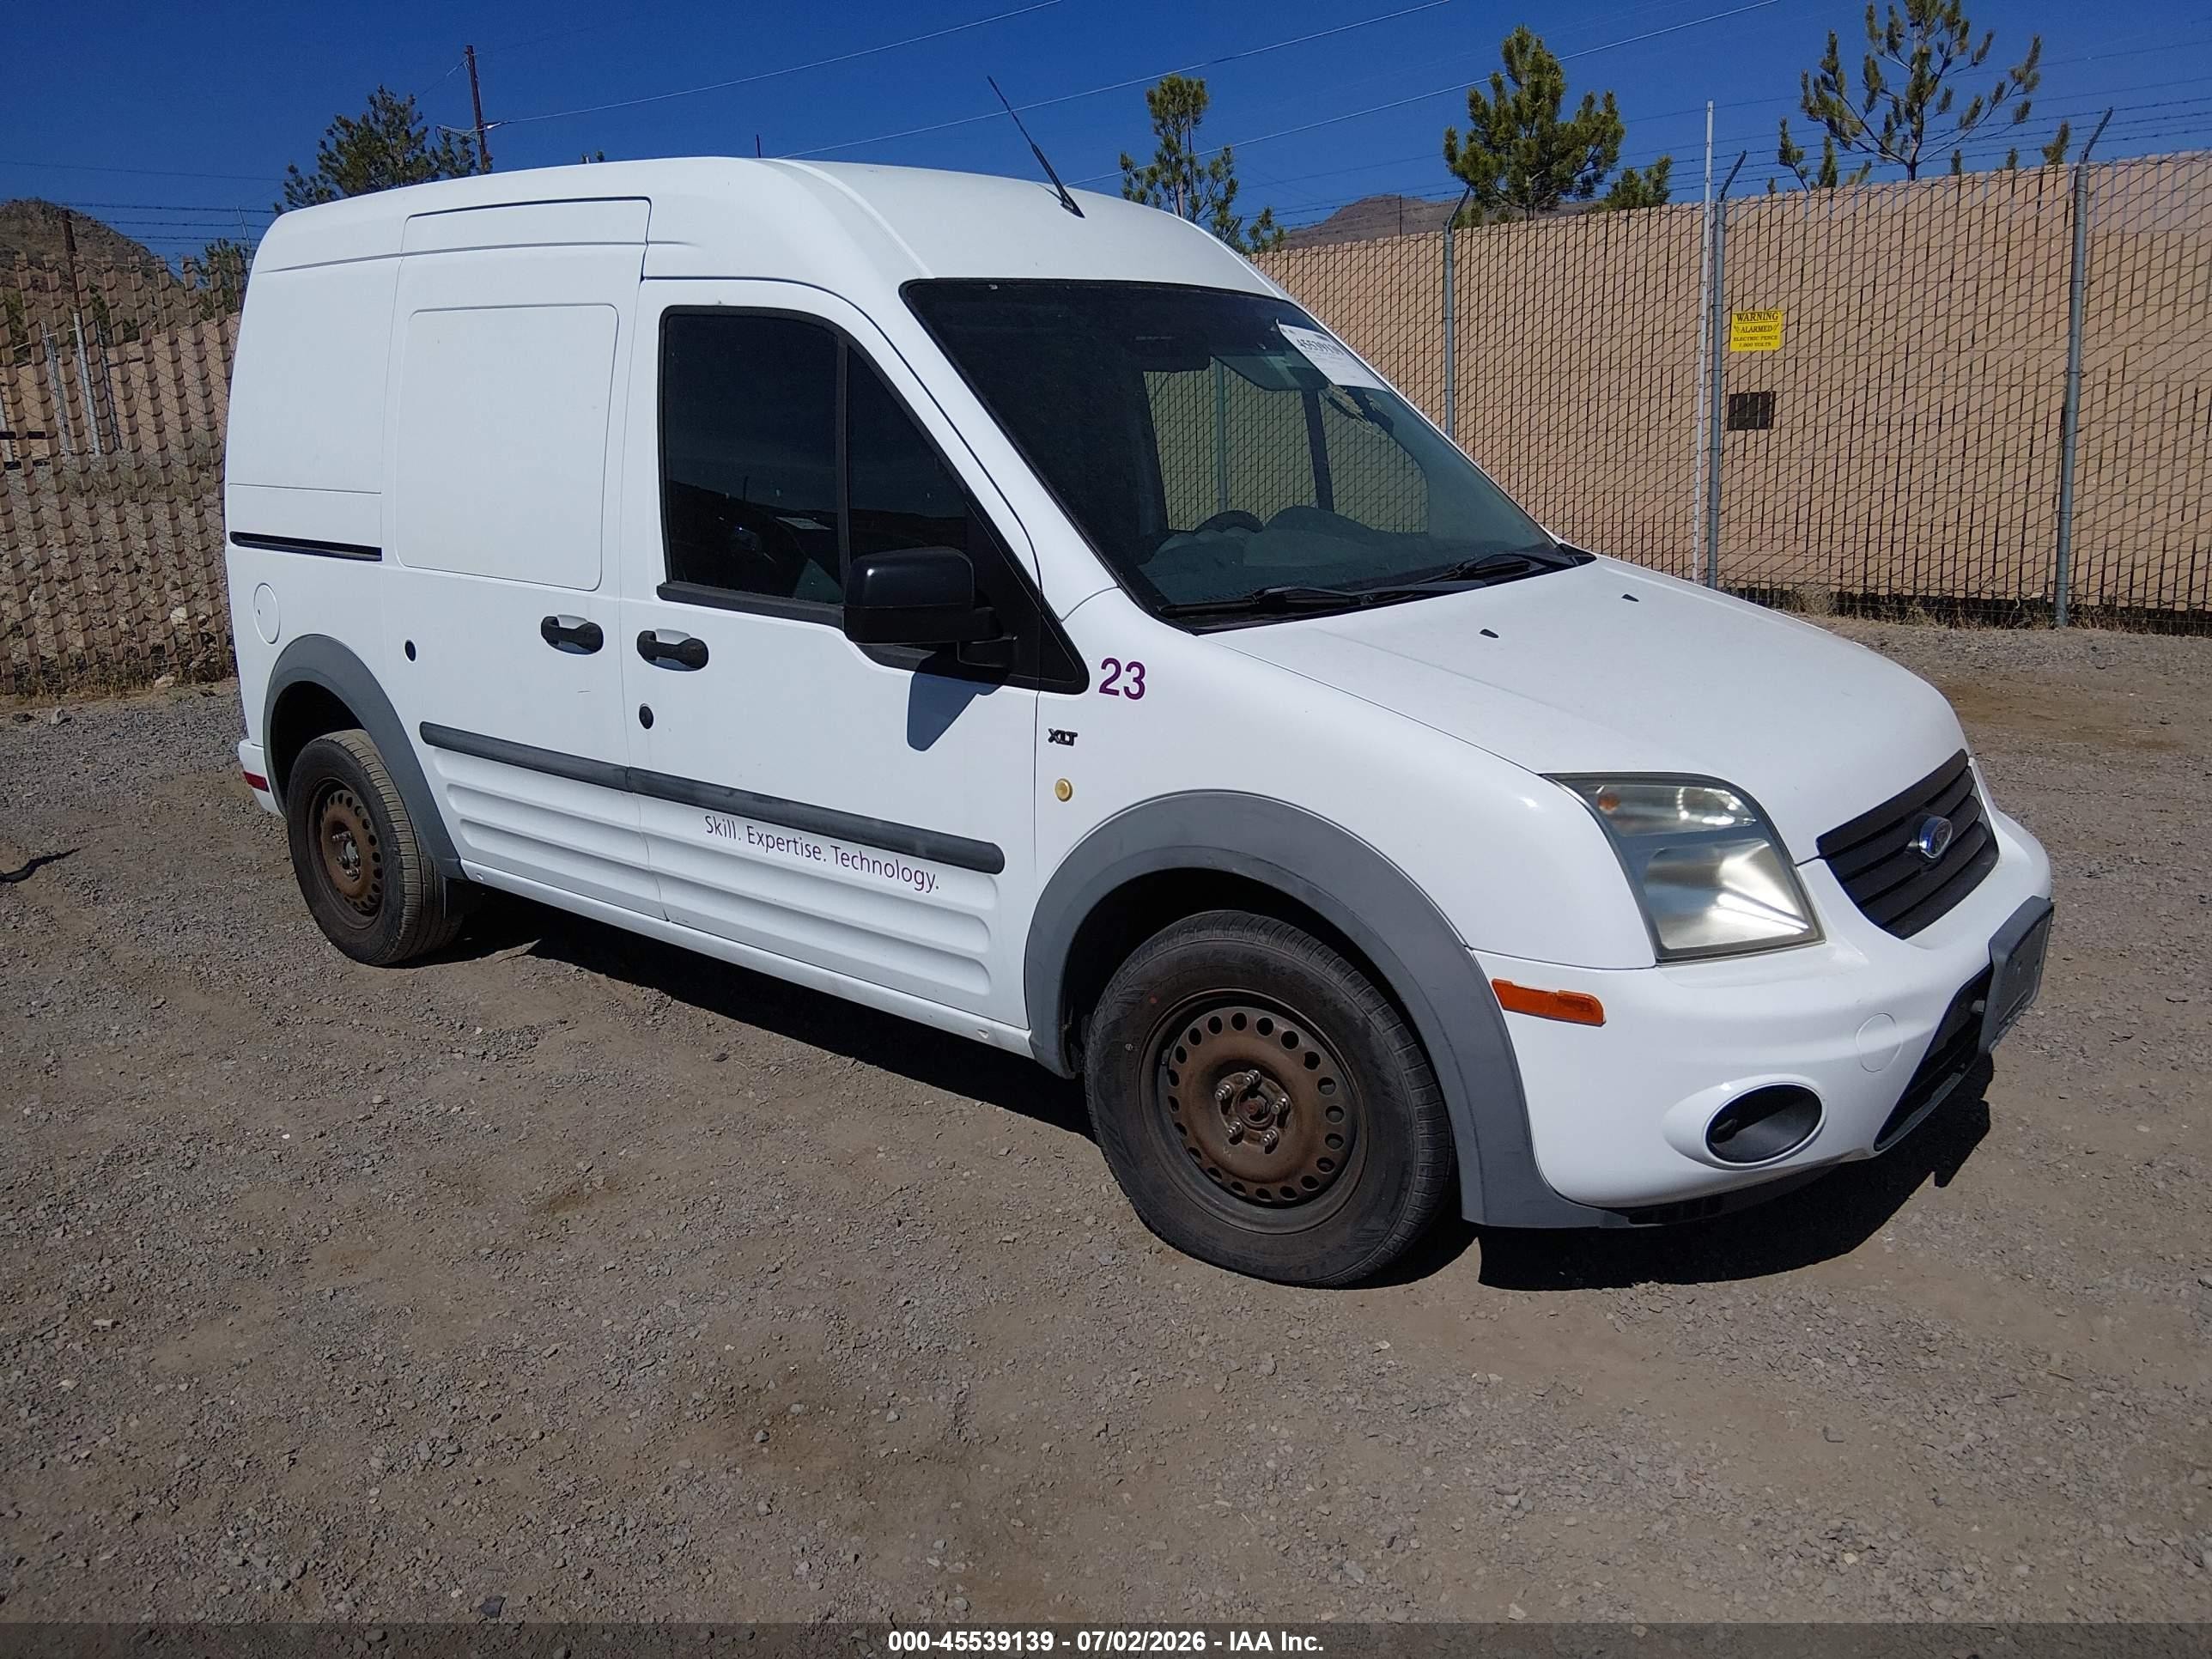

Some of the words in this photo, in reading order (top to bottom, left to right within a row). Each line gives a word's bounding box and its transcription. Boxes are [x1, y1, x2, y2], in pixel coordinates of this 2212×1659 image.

[1736, 312, 1778, 322] WARNING
[1741, 325, 1773, 333] ALARMED
[1098, 657, 1146, 701] 23
[1048, 728, 1079, 746] XLT
[704, 815, 741, 842] Skill.
[746, 825, 827, 862] Expertise.
[830, 844, 940, 894] Technology.
